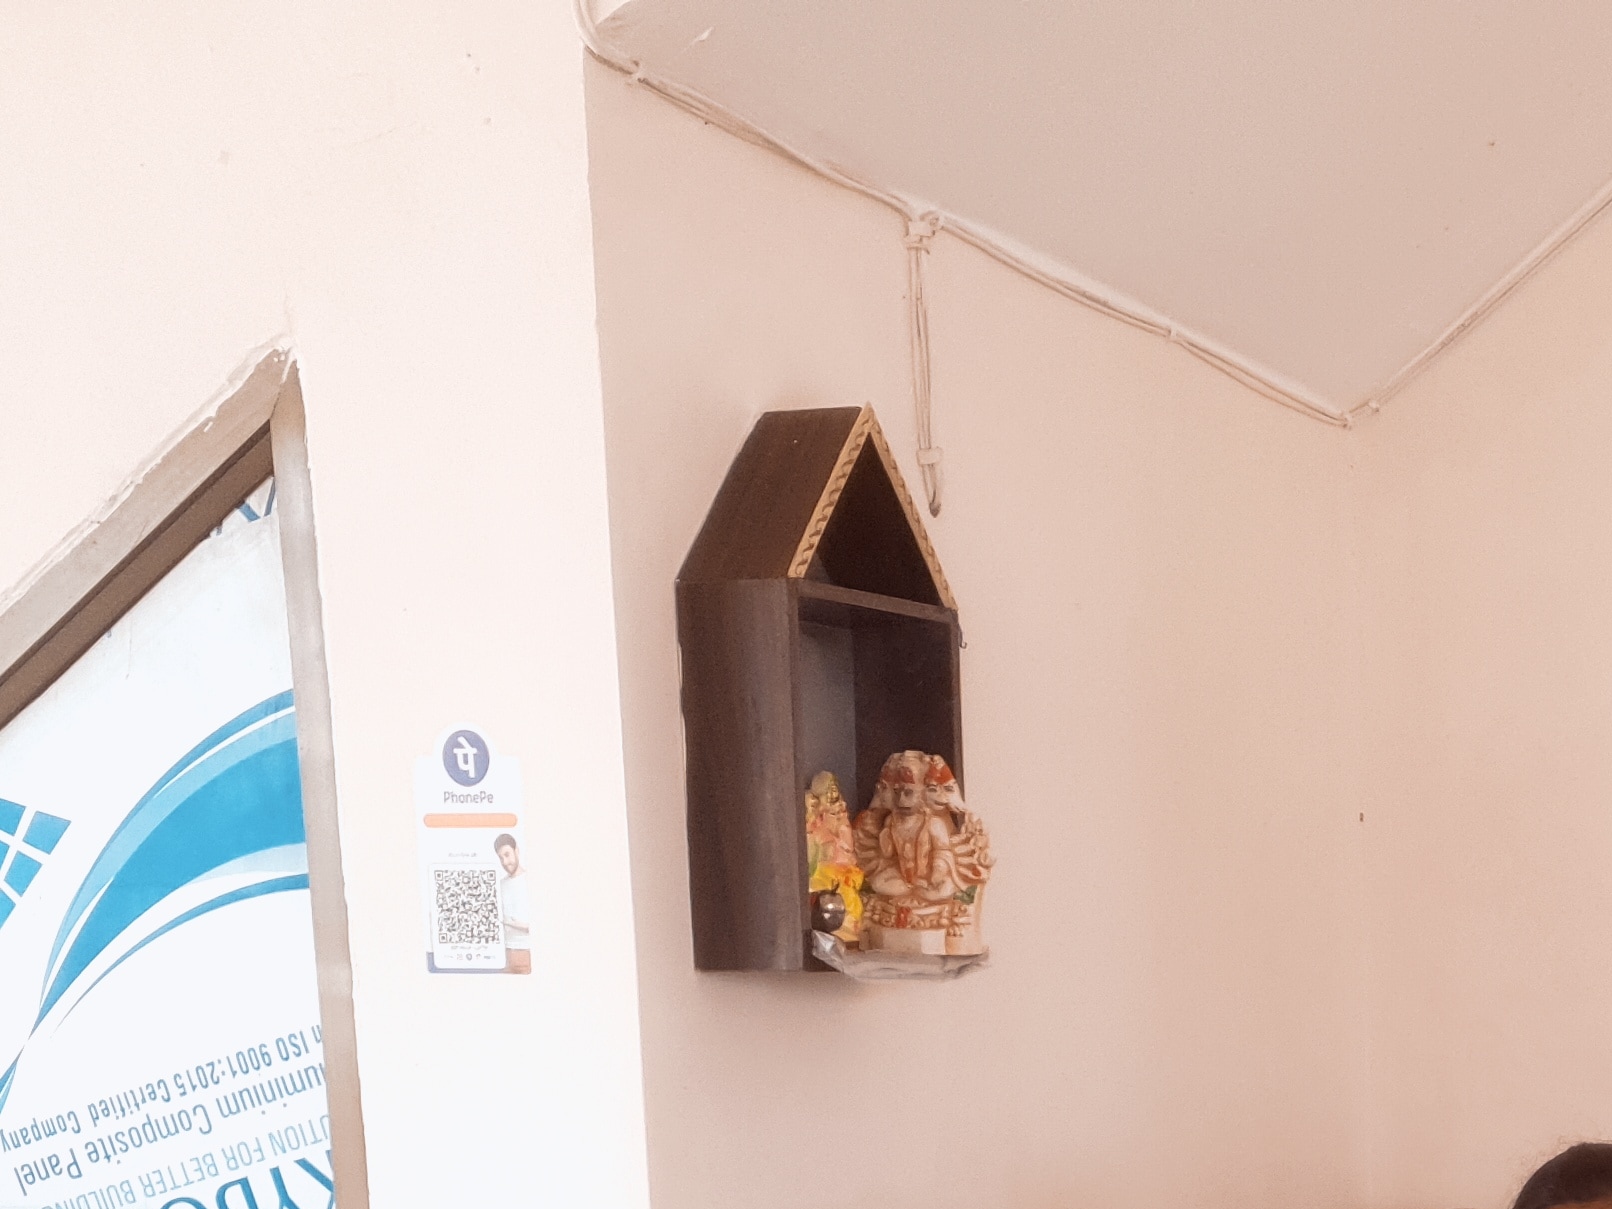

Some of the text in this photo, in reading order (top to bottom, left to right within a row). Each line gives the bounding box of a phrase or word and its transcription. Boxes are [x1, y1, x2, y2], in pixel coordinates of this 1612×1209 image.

[443, 790, 494, 804] PhonePe
[275, 1029, 310, 1063] ISO
[173, 1043, 272, 1099] 9001:2015
[87, 1079, 172, 1128] Certified
[0, 1110, 82, 1152] Company
[84, 1103, 213, 1166] Composite
[222, 1136, 266, 1172] FOR
[13, 1147, 83, 1197] Panel
[138, 1152, 219, 1198] BETTER
